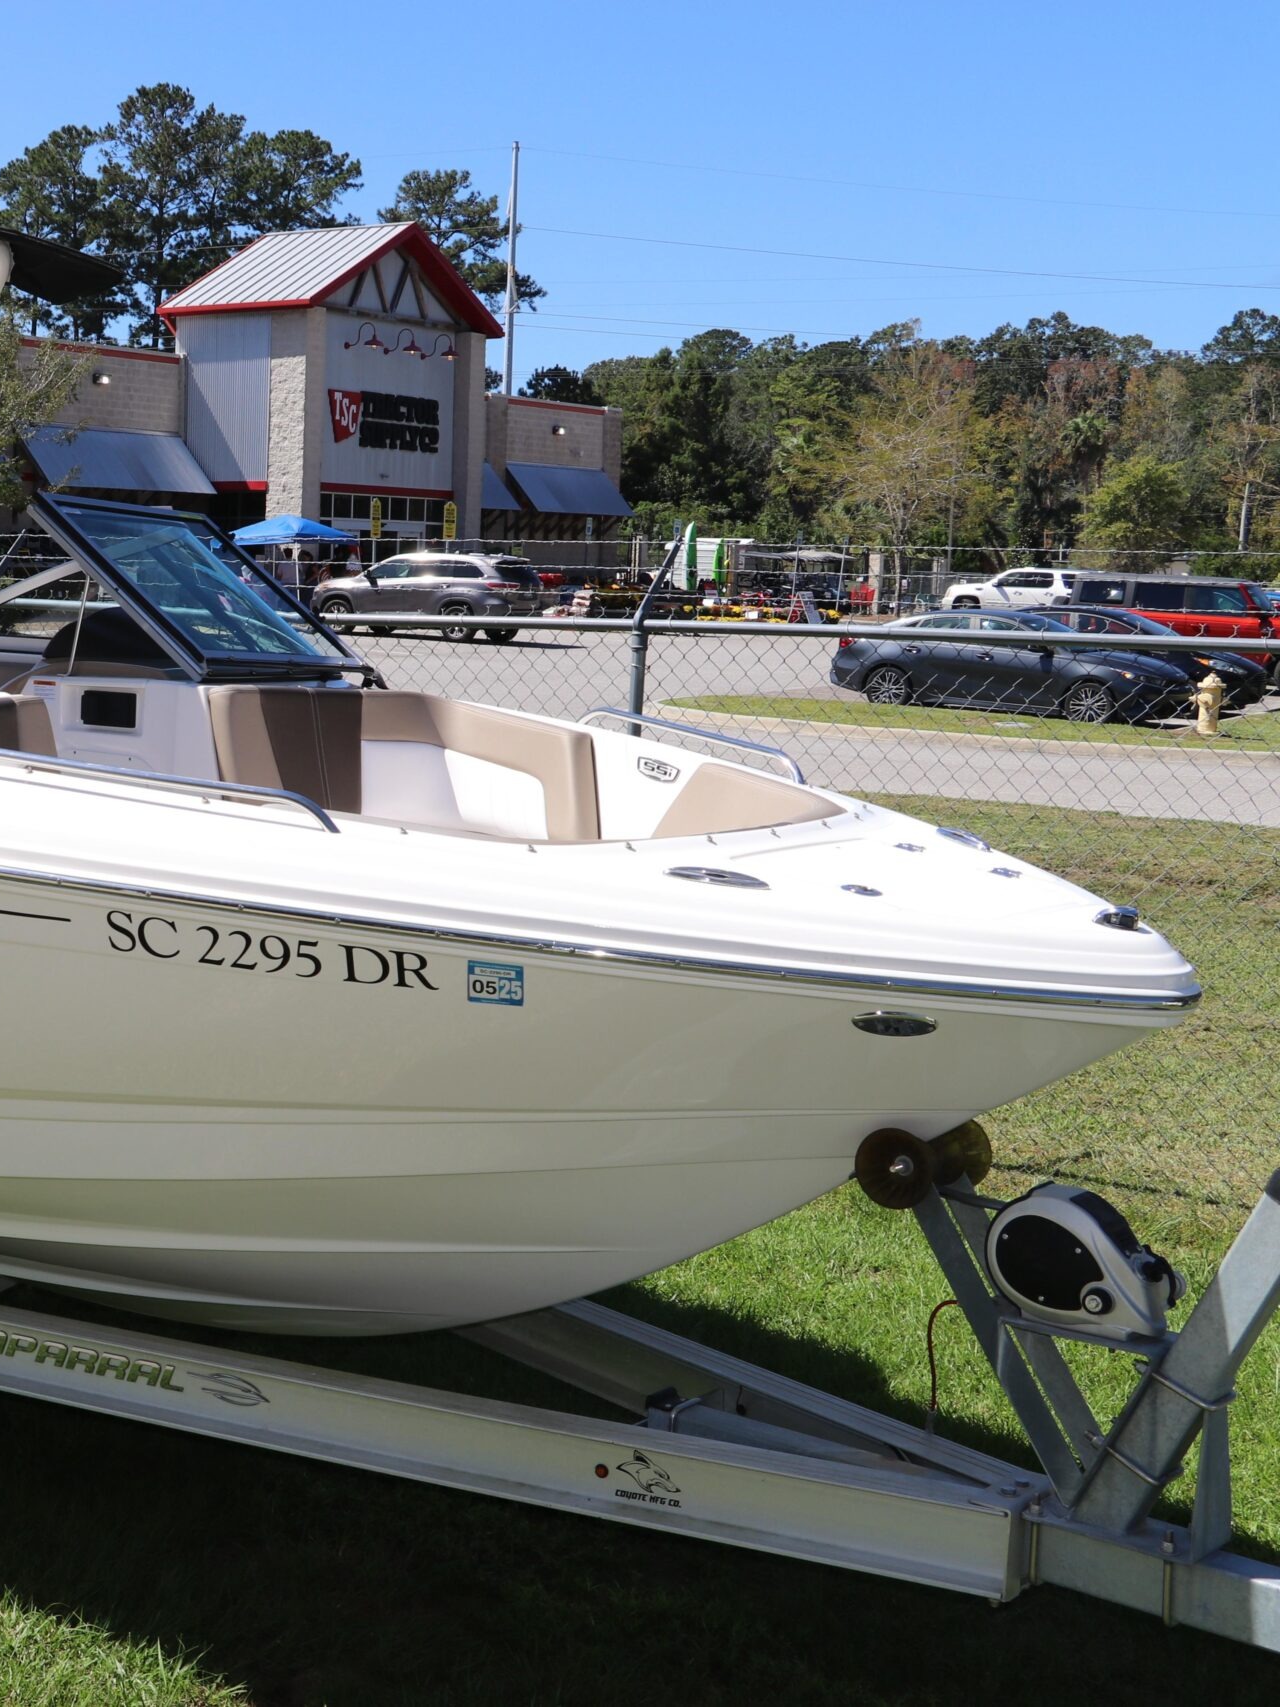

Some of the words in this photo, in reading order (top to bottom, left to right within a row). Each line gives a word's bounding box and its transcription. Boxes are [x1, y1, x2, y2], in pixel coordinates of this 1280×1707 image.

[334, 391, 357, 434] TSC
[106, 910, 180, 959] SC
[197, 925, 323, 978] 2295
[338, 944, 439, 991] DR
[472, 979, 497, 995] 05
[499, 979, 523, 1000] 25
[615, 1489, 648, 1502] COYOTE
[649, 1495, 668, 1505] MFG
